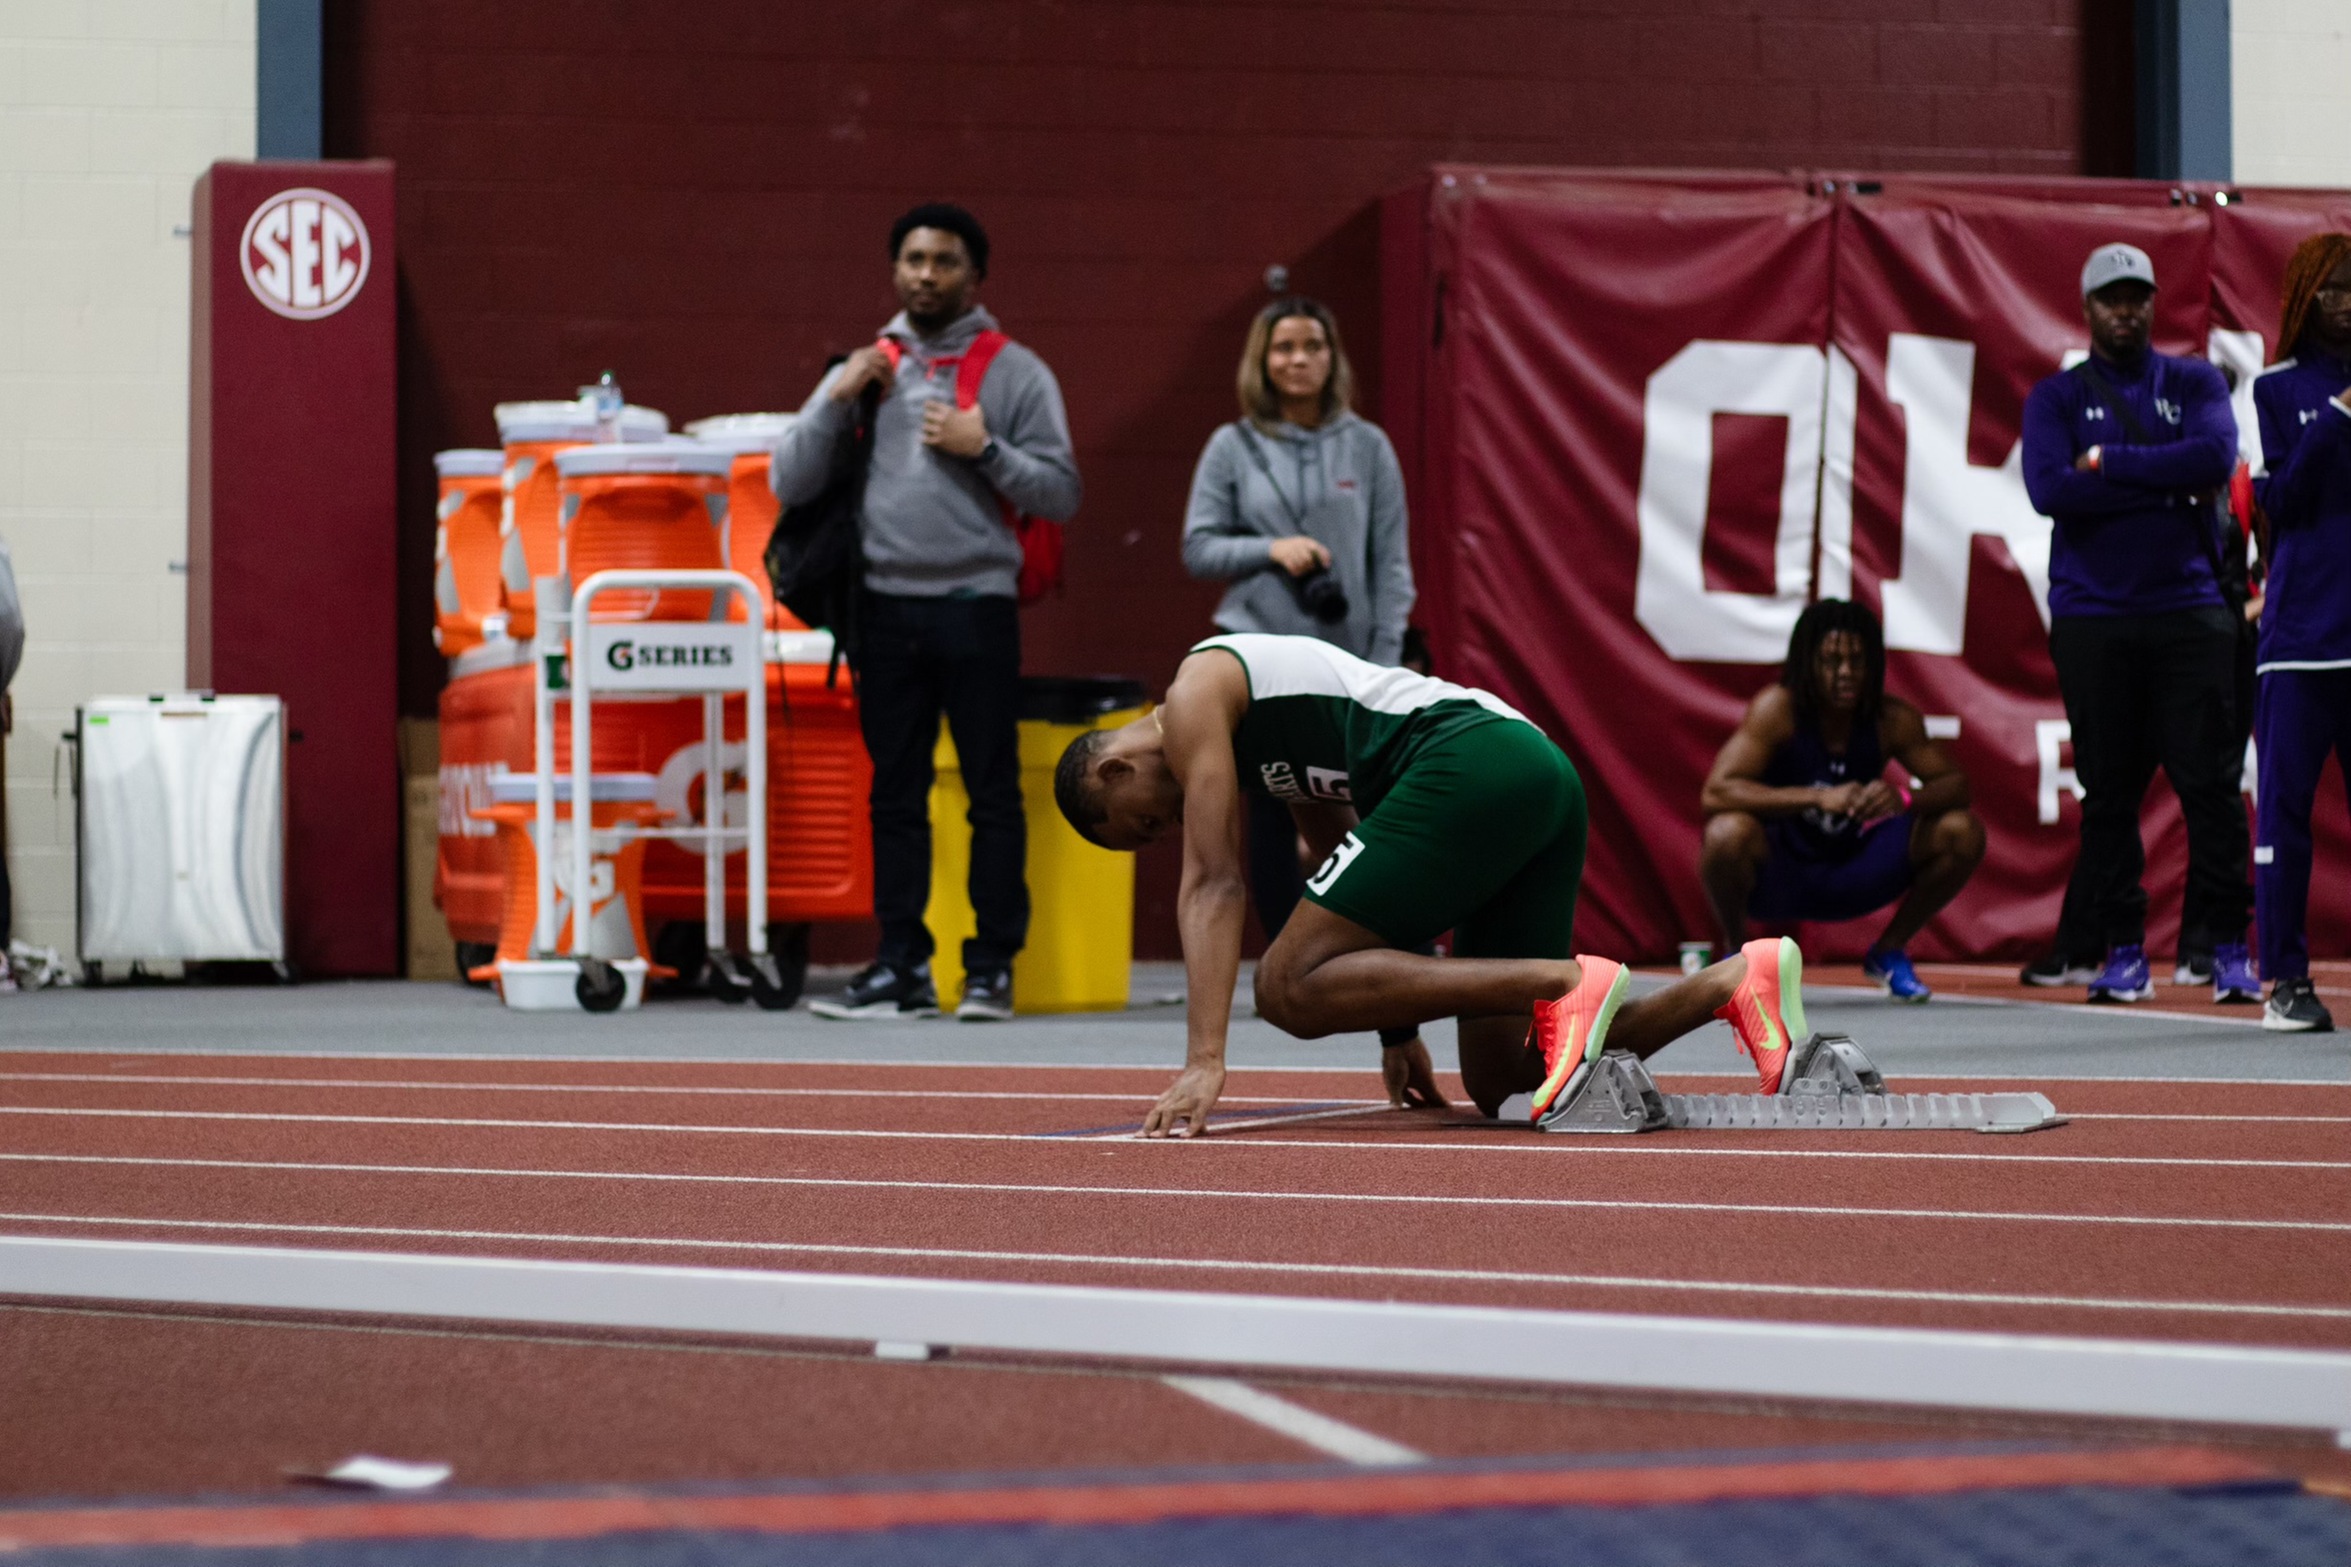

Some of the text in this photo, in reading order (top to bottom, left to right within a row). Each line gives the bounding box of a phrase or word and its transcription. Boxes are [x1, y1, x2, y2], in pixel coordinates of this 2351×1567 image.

[251, 199, 358, 307] SEC
[1634, 332, 2268, 665] OK
[638, 645, 733, 667] SERIES
